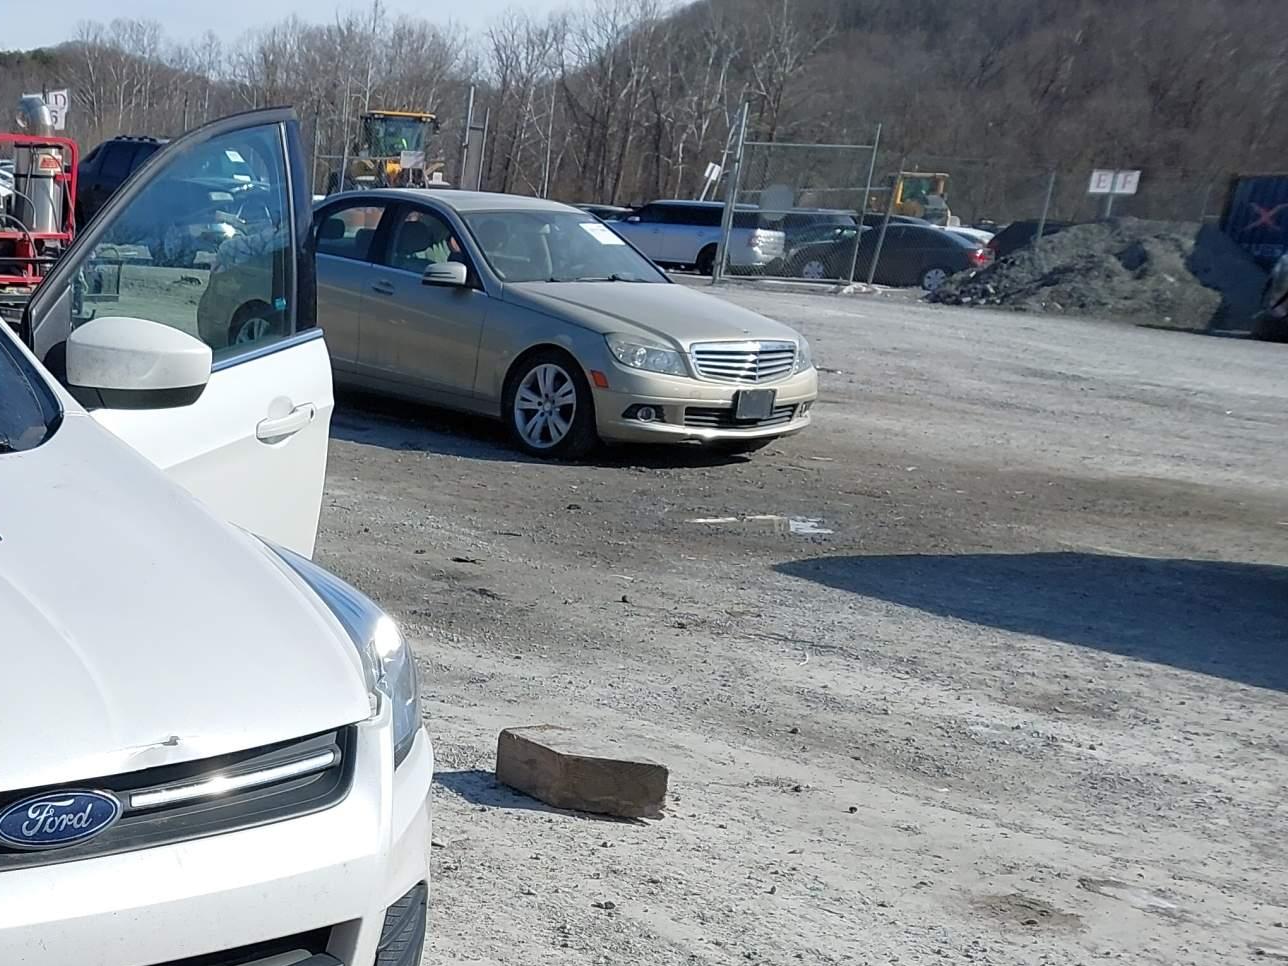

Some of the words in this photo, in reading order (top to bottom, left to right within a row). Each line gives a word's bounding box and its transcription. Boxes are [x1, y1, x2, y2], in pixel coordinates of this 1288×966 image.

[54, 93, 67, 107] D
[1095, 173, 1107, 189] E
[21, 798, 93, 837] Ford
